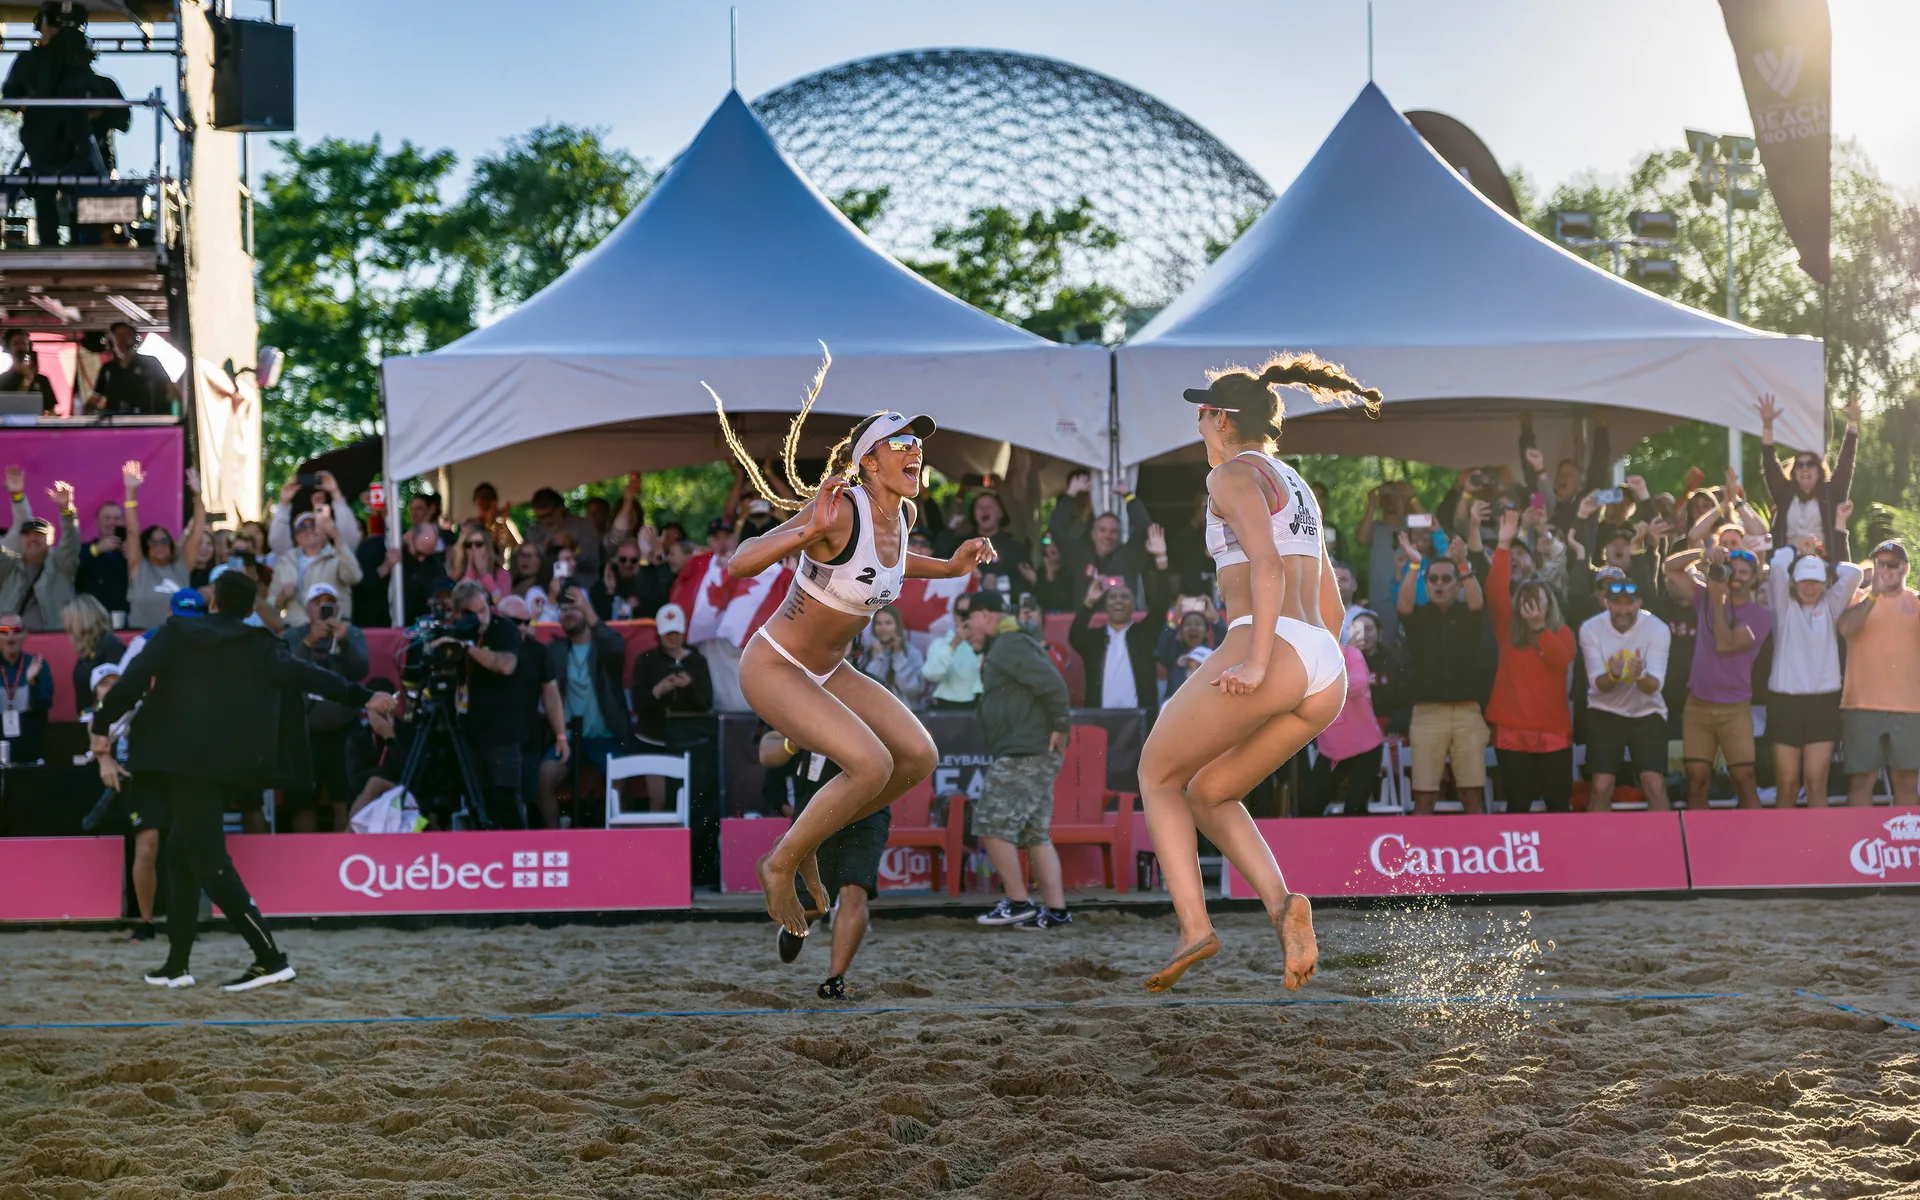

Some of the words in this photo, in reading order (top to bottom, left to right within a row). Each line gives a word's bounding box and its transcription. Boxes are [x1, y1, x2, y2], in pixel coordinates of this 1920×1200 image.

[1761, 128, 1787, 144] RO
[1295, 491, 1303, 506] 1
[855, 567, 876, 585] 2
[1370, 832, 1544, 876] Canada
[1850, 837, 1920, 879] Cor
[339, 853, 506, 898] Québec
